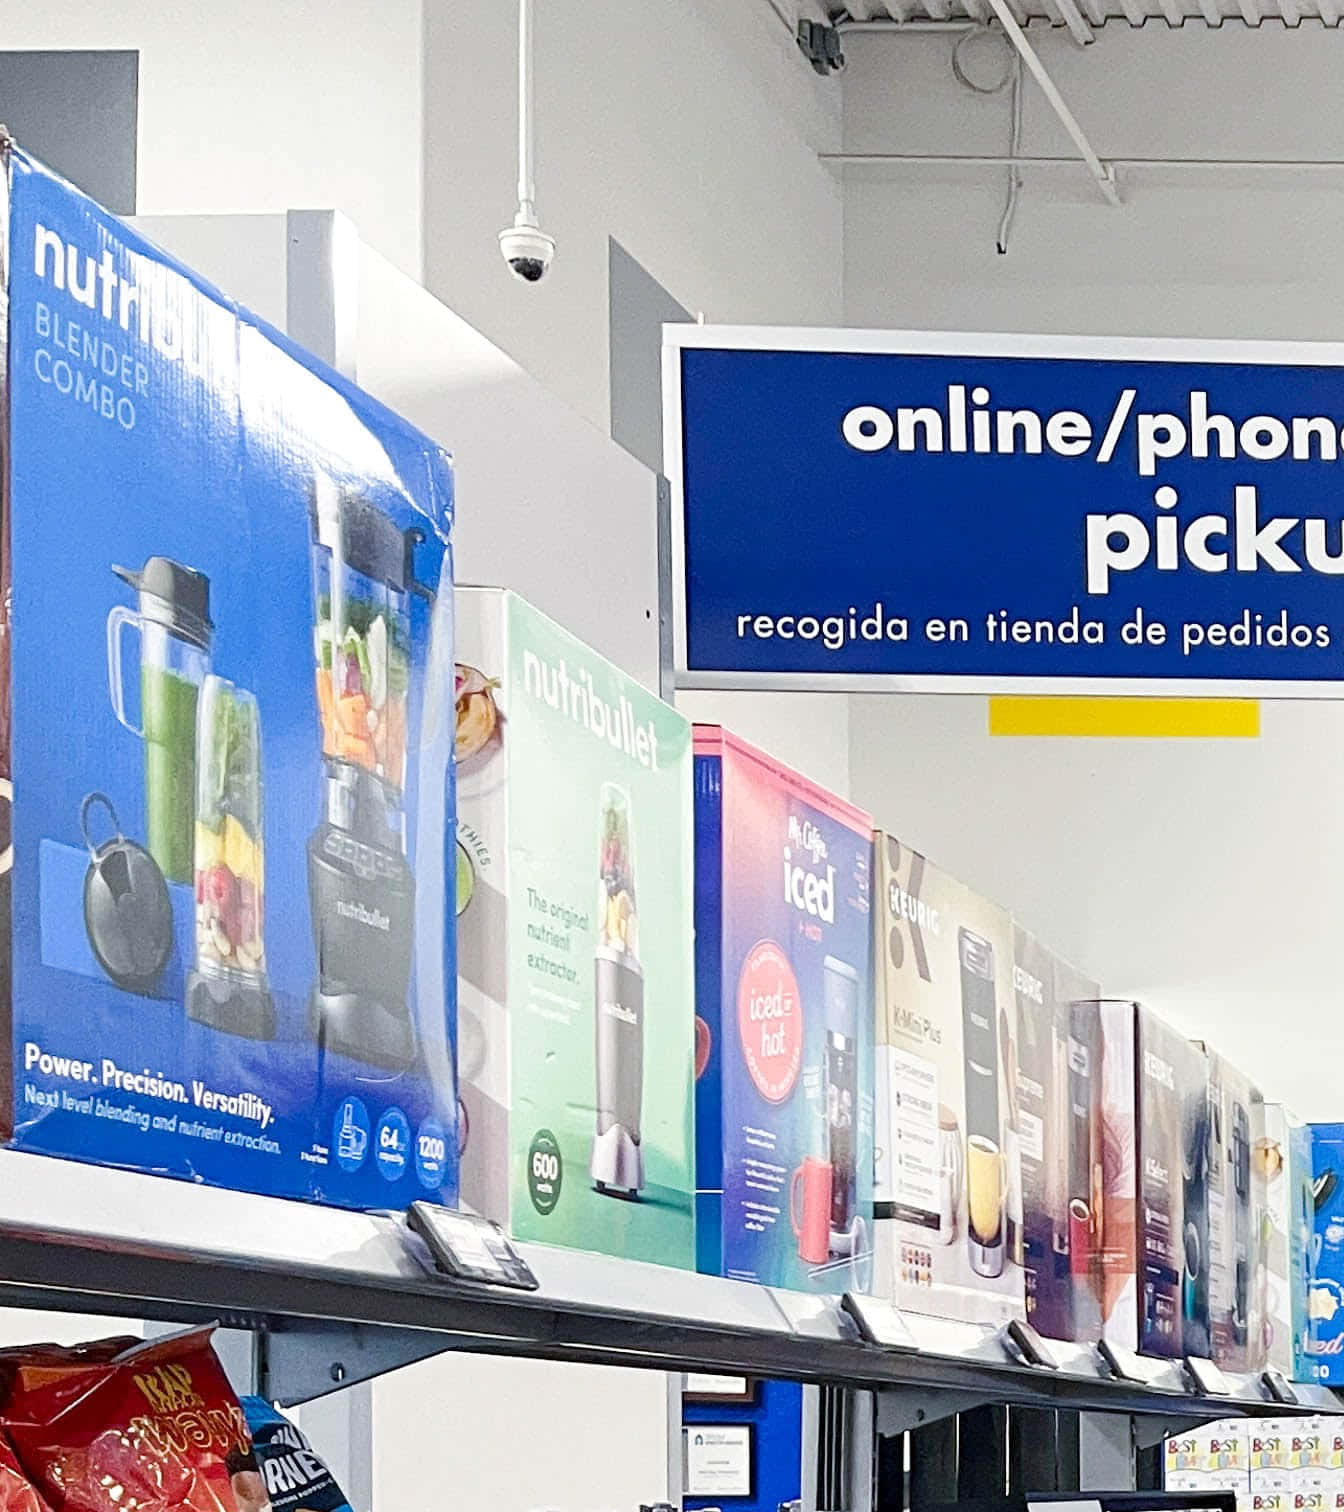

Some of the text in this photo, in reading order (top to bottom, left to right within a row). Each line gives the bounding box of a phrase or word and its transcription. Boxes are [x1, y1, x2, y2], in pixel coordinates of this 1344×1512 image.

[35, 301, 149, 397] BLENDER
[34, 348, 136, 431] COMBO
[737, 604, 908, 649] recogida
[926, 618, 969, 642] en
[986, 607, 1104, 644] tienda
[1121, 607, 1166, 645] de
[1182, 608, 1330, 655] pedidos
[522, 646, 662, 776] nutribullet
[459, 823, 491, 867] THIES
[783, 846, 834, 925] iced
[336, 899, 392, 932] nutribullet
[526, 886, 590, 938] The original
[526, 922, 572, 954] nutrient
[760, 1022, 786, 1057] hot
[24, 1042, 276, 1125] Power. Precision. Versatility.
[24, 1084, 59, 1110] Next
[61, 1090, 92, 1117] level
[95, 1096, 150, 1132] blending
[152, 1107, 177, 1133] and
[179, 1113, 222, 1142] nutrient
[380, 1125, 400, 1148] 64
[418, 1134, 445, 1161] 1200
[532, 1151, 558, 1180] 600
